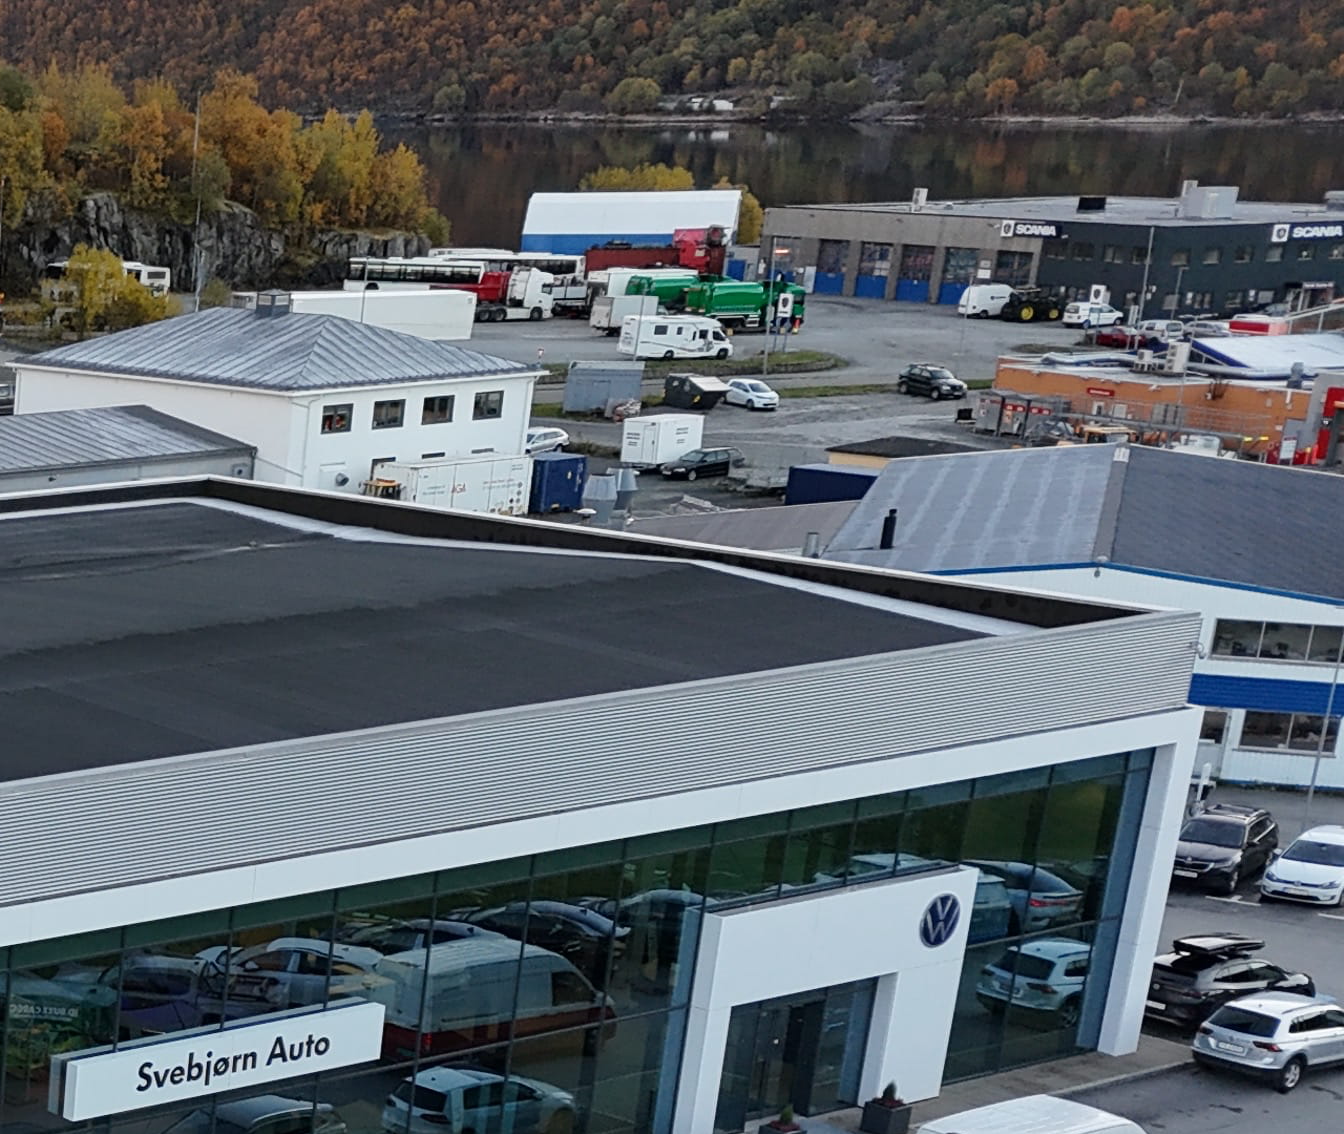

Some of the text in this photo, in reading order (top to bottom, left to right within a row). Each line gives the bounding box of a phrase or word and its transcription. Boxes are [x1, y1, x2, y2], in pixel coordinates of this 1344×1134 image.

[1015, 224, 1056, 236] SCANIA
[1292, 226, 1343, 238] SCANIA
[136, 1034, 330, 1091] Svebjørn Auto
